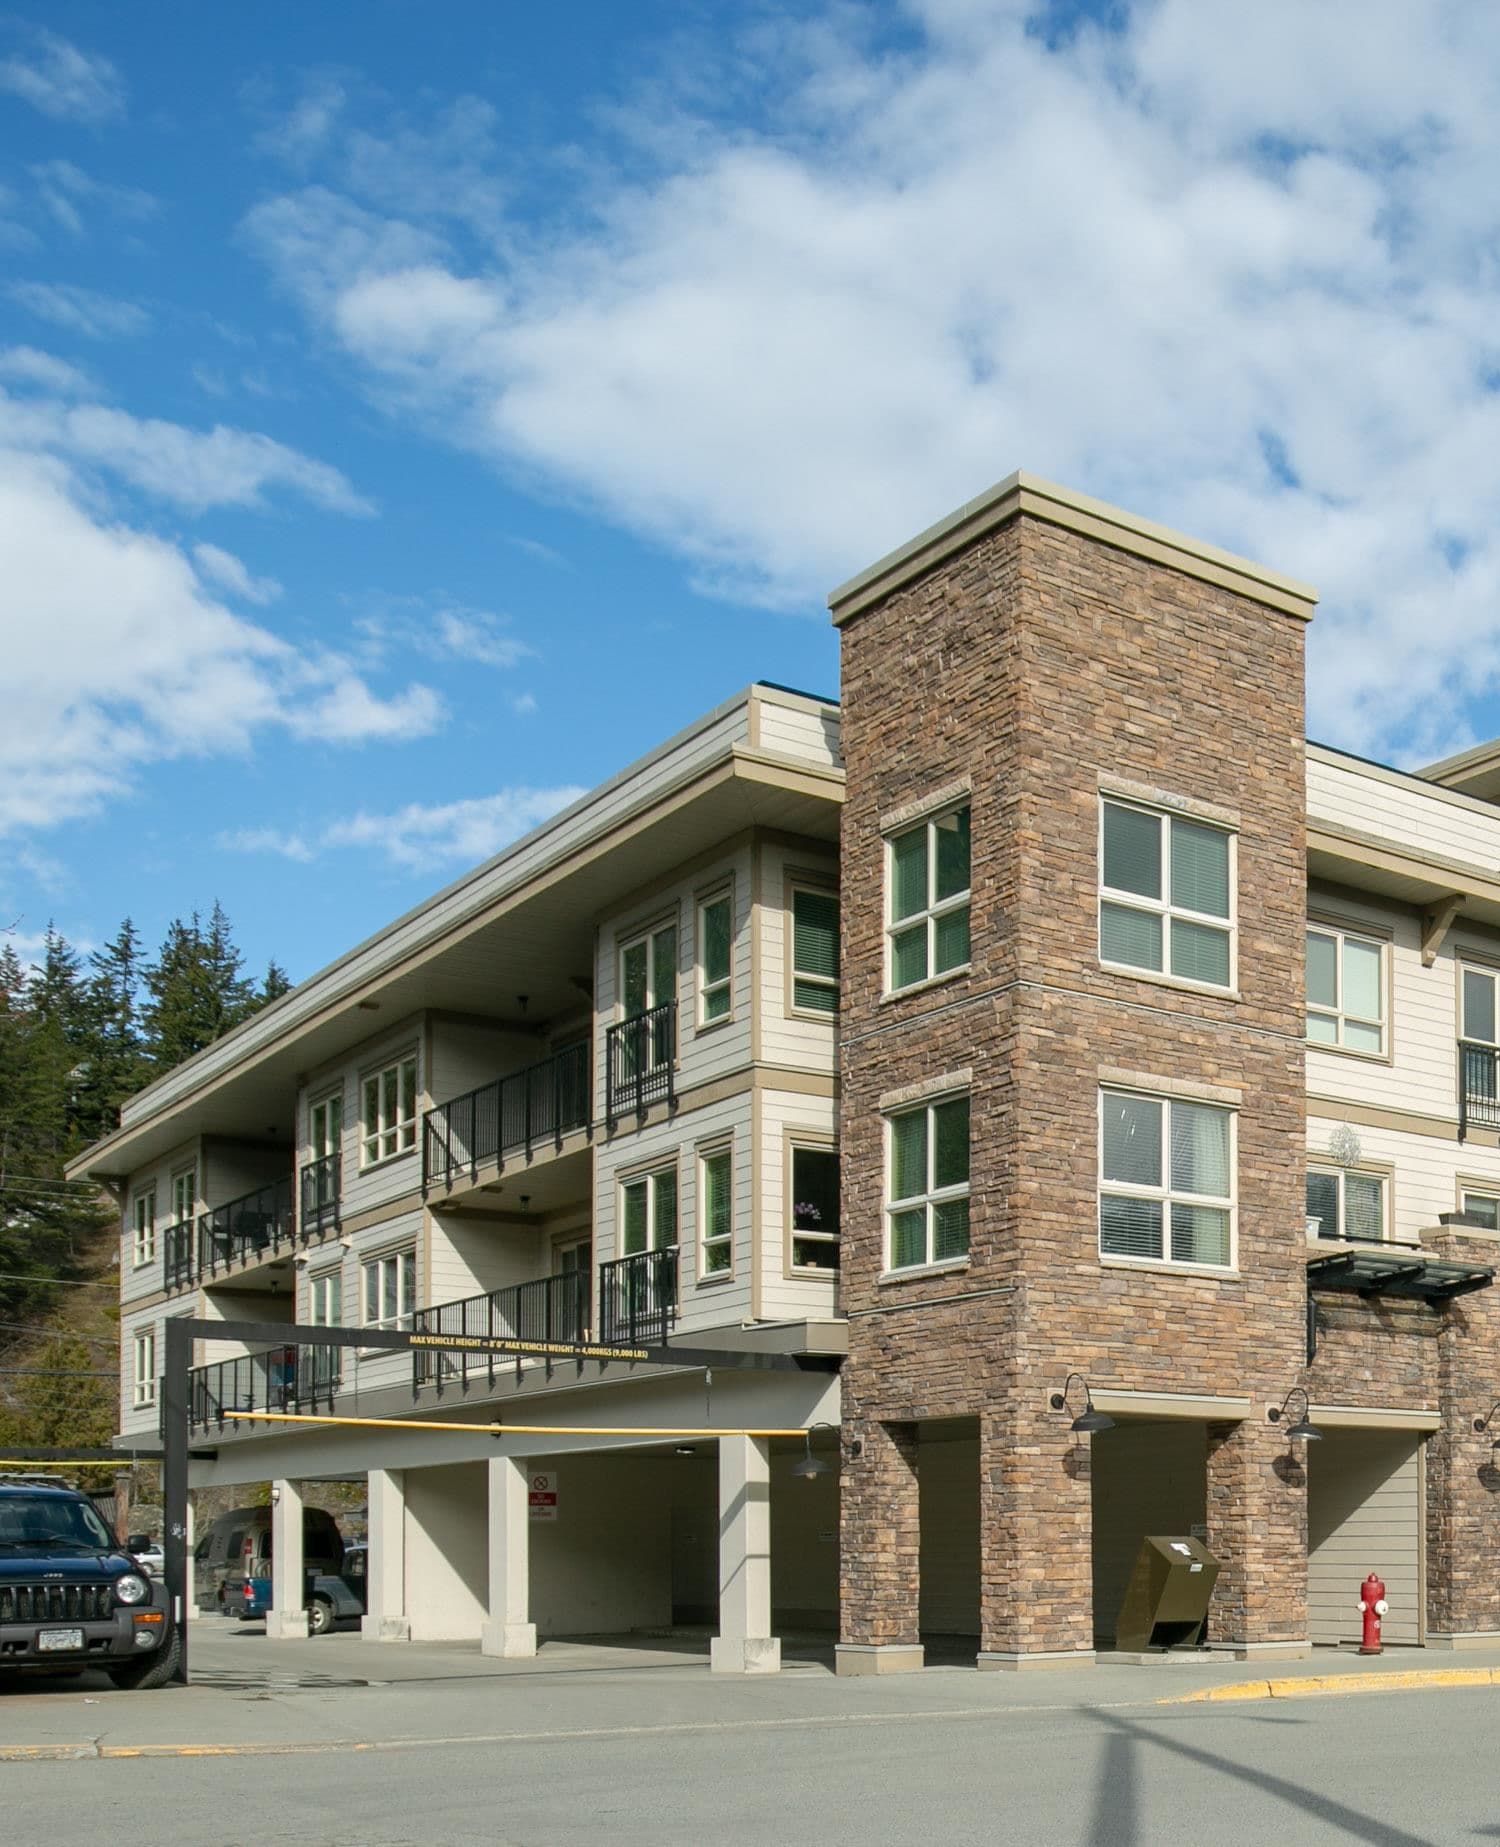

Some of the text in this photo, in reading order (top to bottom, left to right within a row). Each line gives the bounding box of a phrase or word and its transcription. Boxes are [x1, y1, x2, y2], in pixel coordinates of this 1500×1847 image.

[409, 1335, 425, 1345] MAX
[426, 1336, 455, 1346] VEHICLE
[455, 1337, 481, 1347] HEIGHT
[505, 1341, 520, 1350] MAX
[520, 1342, 547, 1352] VEHICLE
[548, 1344, 574, 1353] WEIGHT
[581, 1346, 612, 1357] 4,000KGS
[612, 1348, 633, 1358] (9,000
[633, 1350, 648, 1360] LBS)
